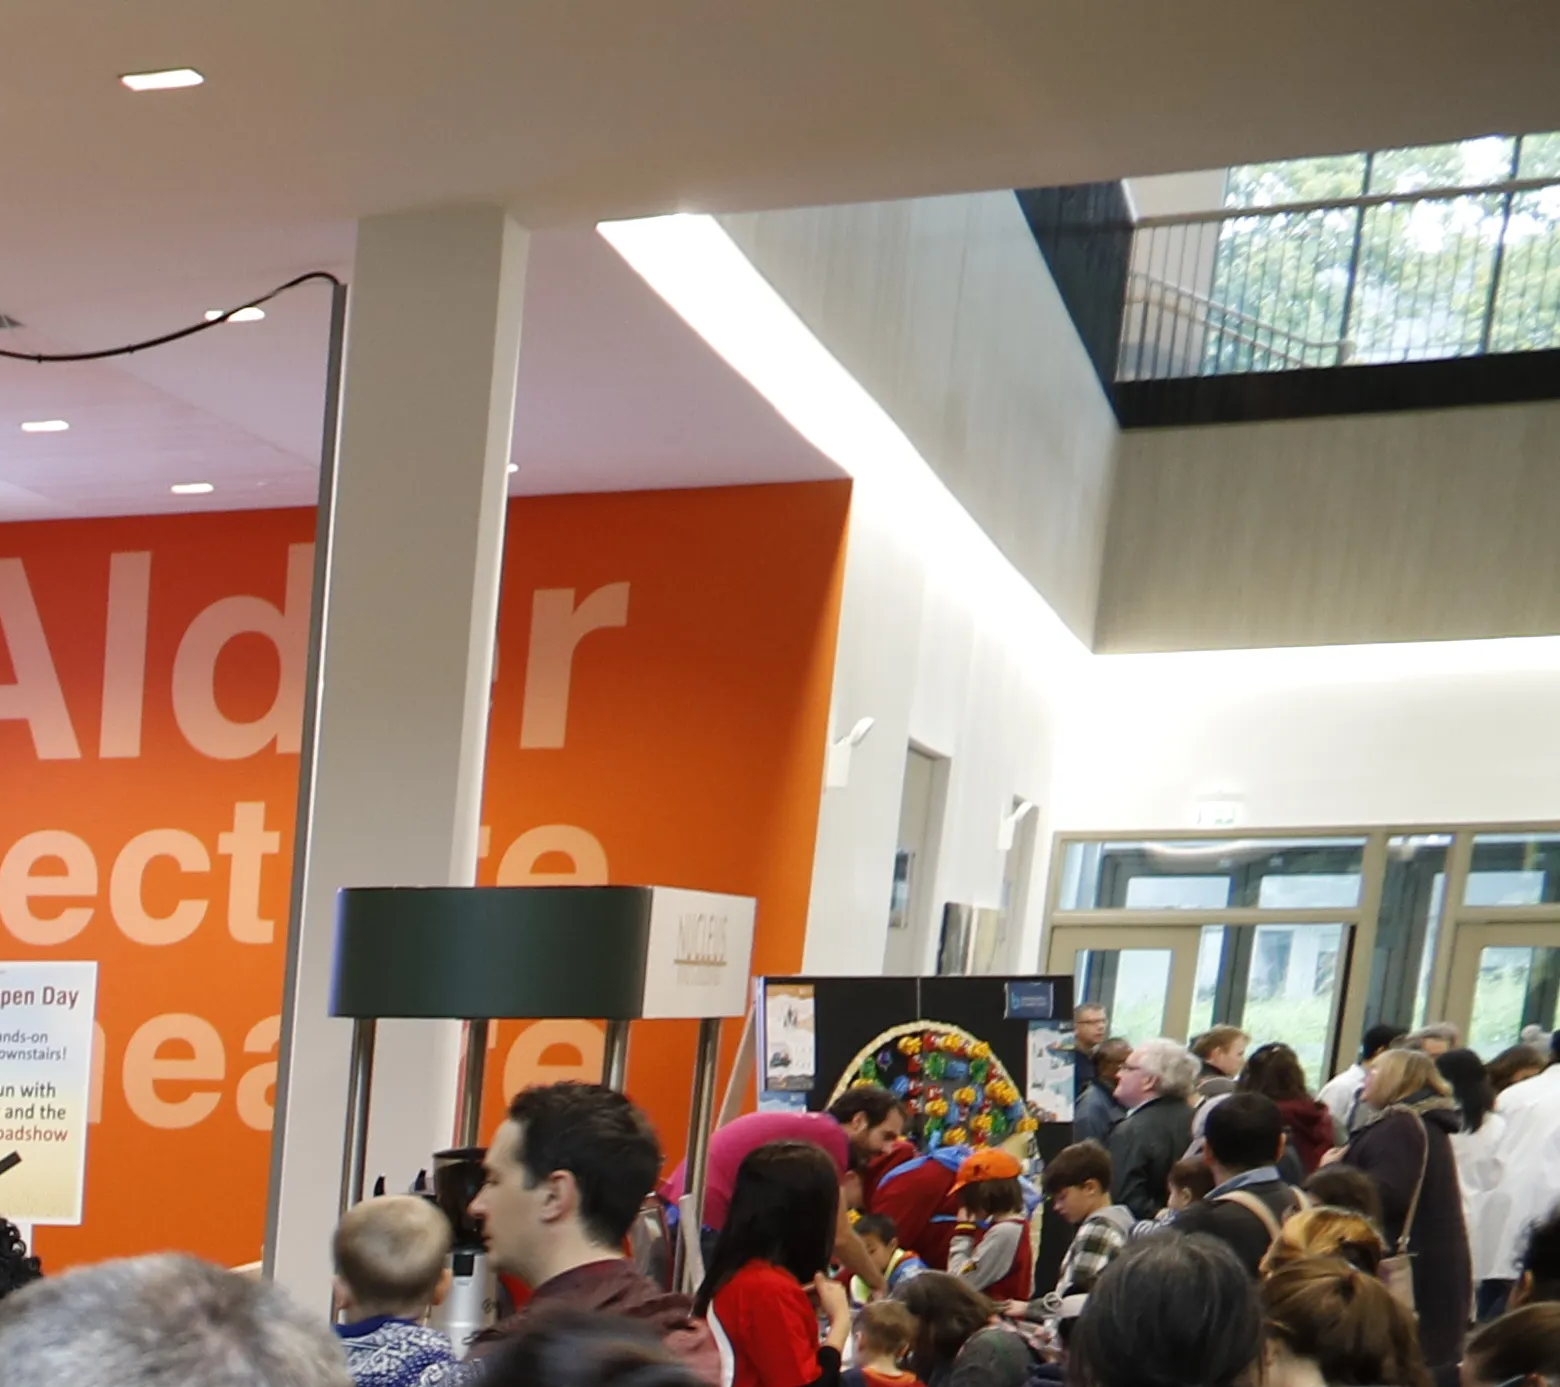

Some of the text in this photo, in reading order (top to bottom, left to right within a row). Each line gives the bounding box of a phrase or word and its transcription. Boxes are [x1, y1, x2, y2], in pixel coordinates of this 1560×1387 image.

[42, 985, 79, 1010] Day
[20, 1081, 56, 1099] with
[5, 1103, 34, 1120] and
[40, 1103, 66, 1120] the
